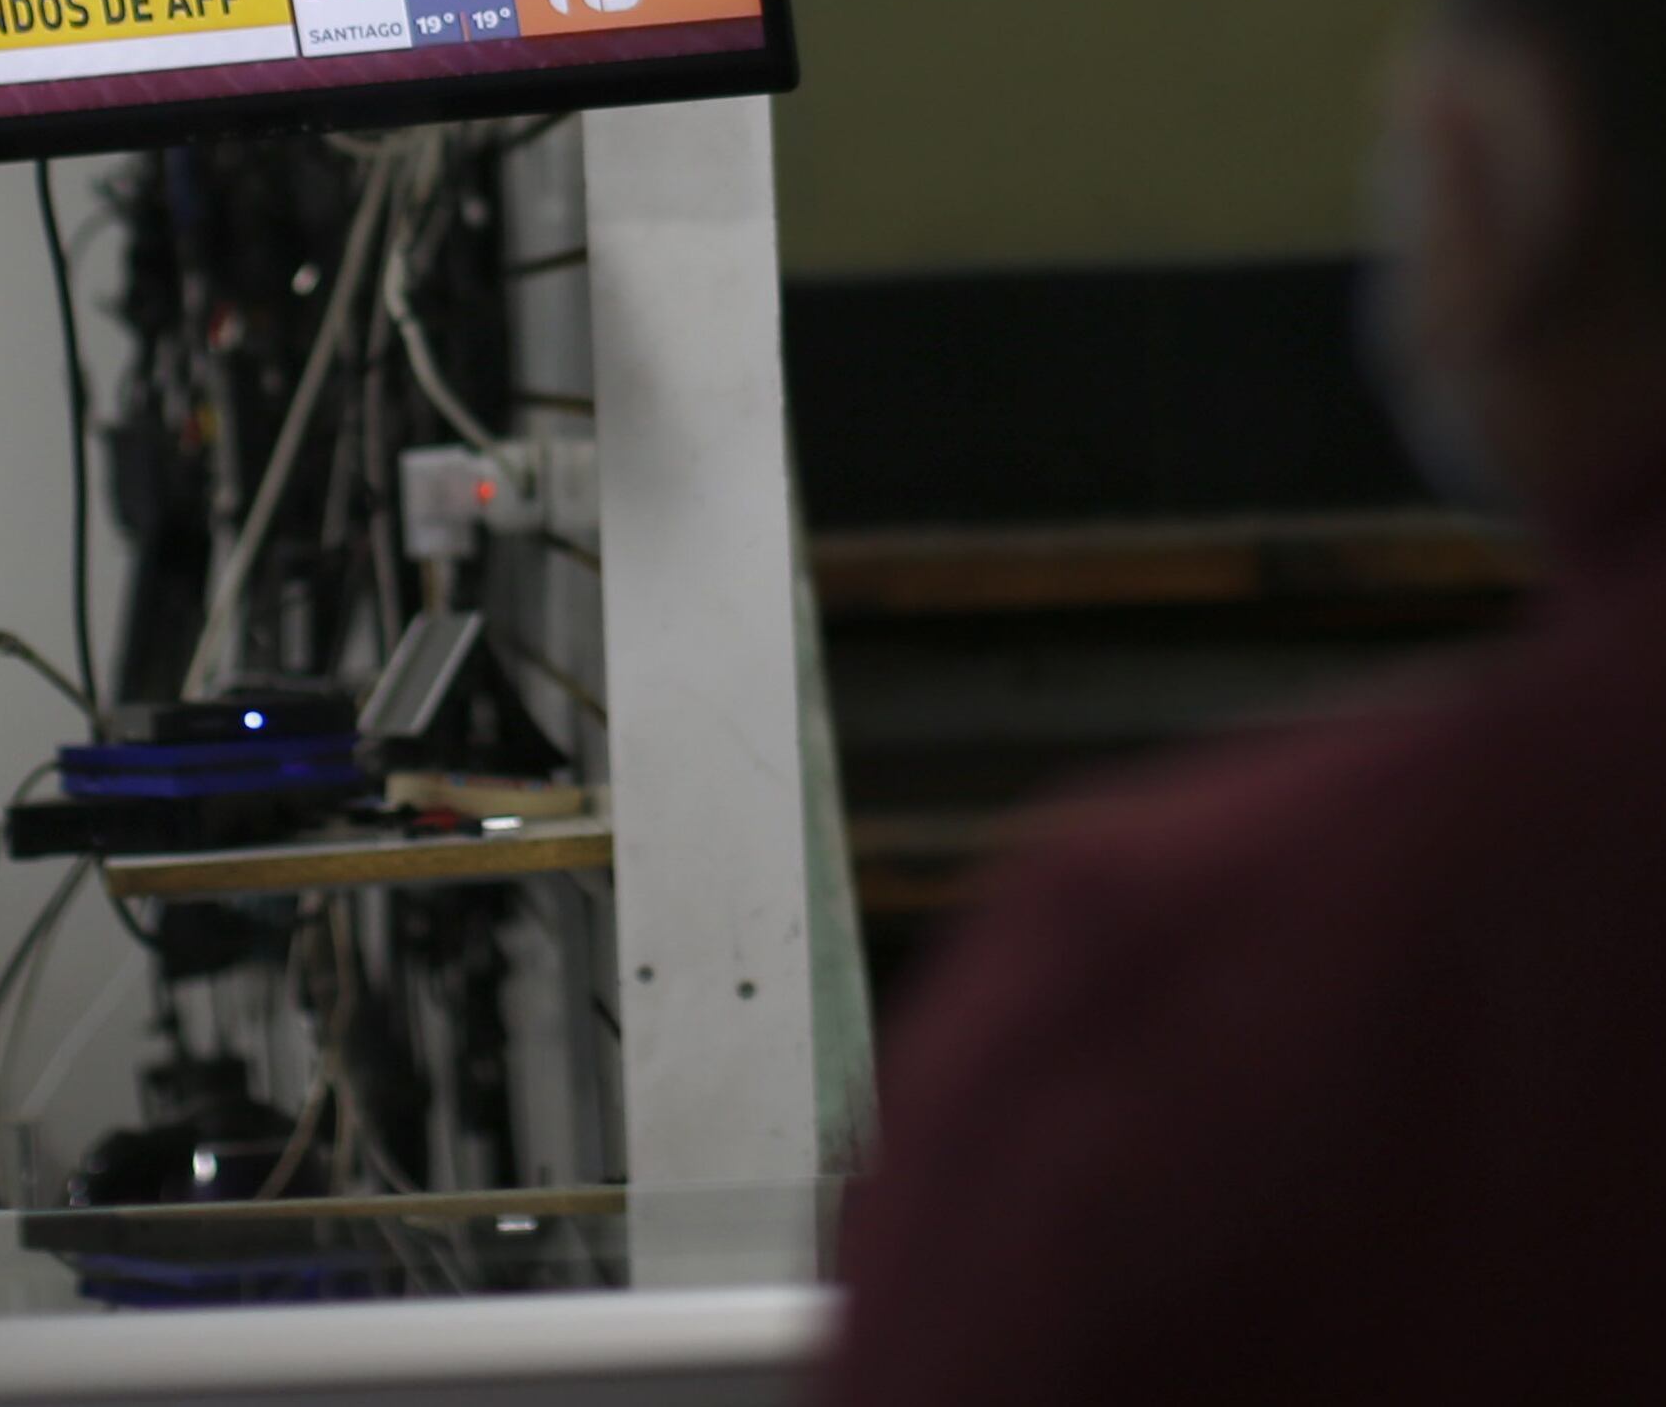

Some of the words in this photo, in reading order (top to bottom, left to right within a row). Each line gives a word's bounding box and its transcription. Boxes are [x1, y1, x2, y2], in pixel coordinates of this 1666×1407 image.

[415, 11, 455, 36] 19°
[472, 5, 511, 31] 19°
[309, 20, 404, 44] SANTIAGO
